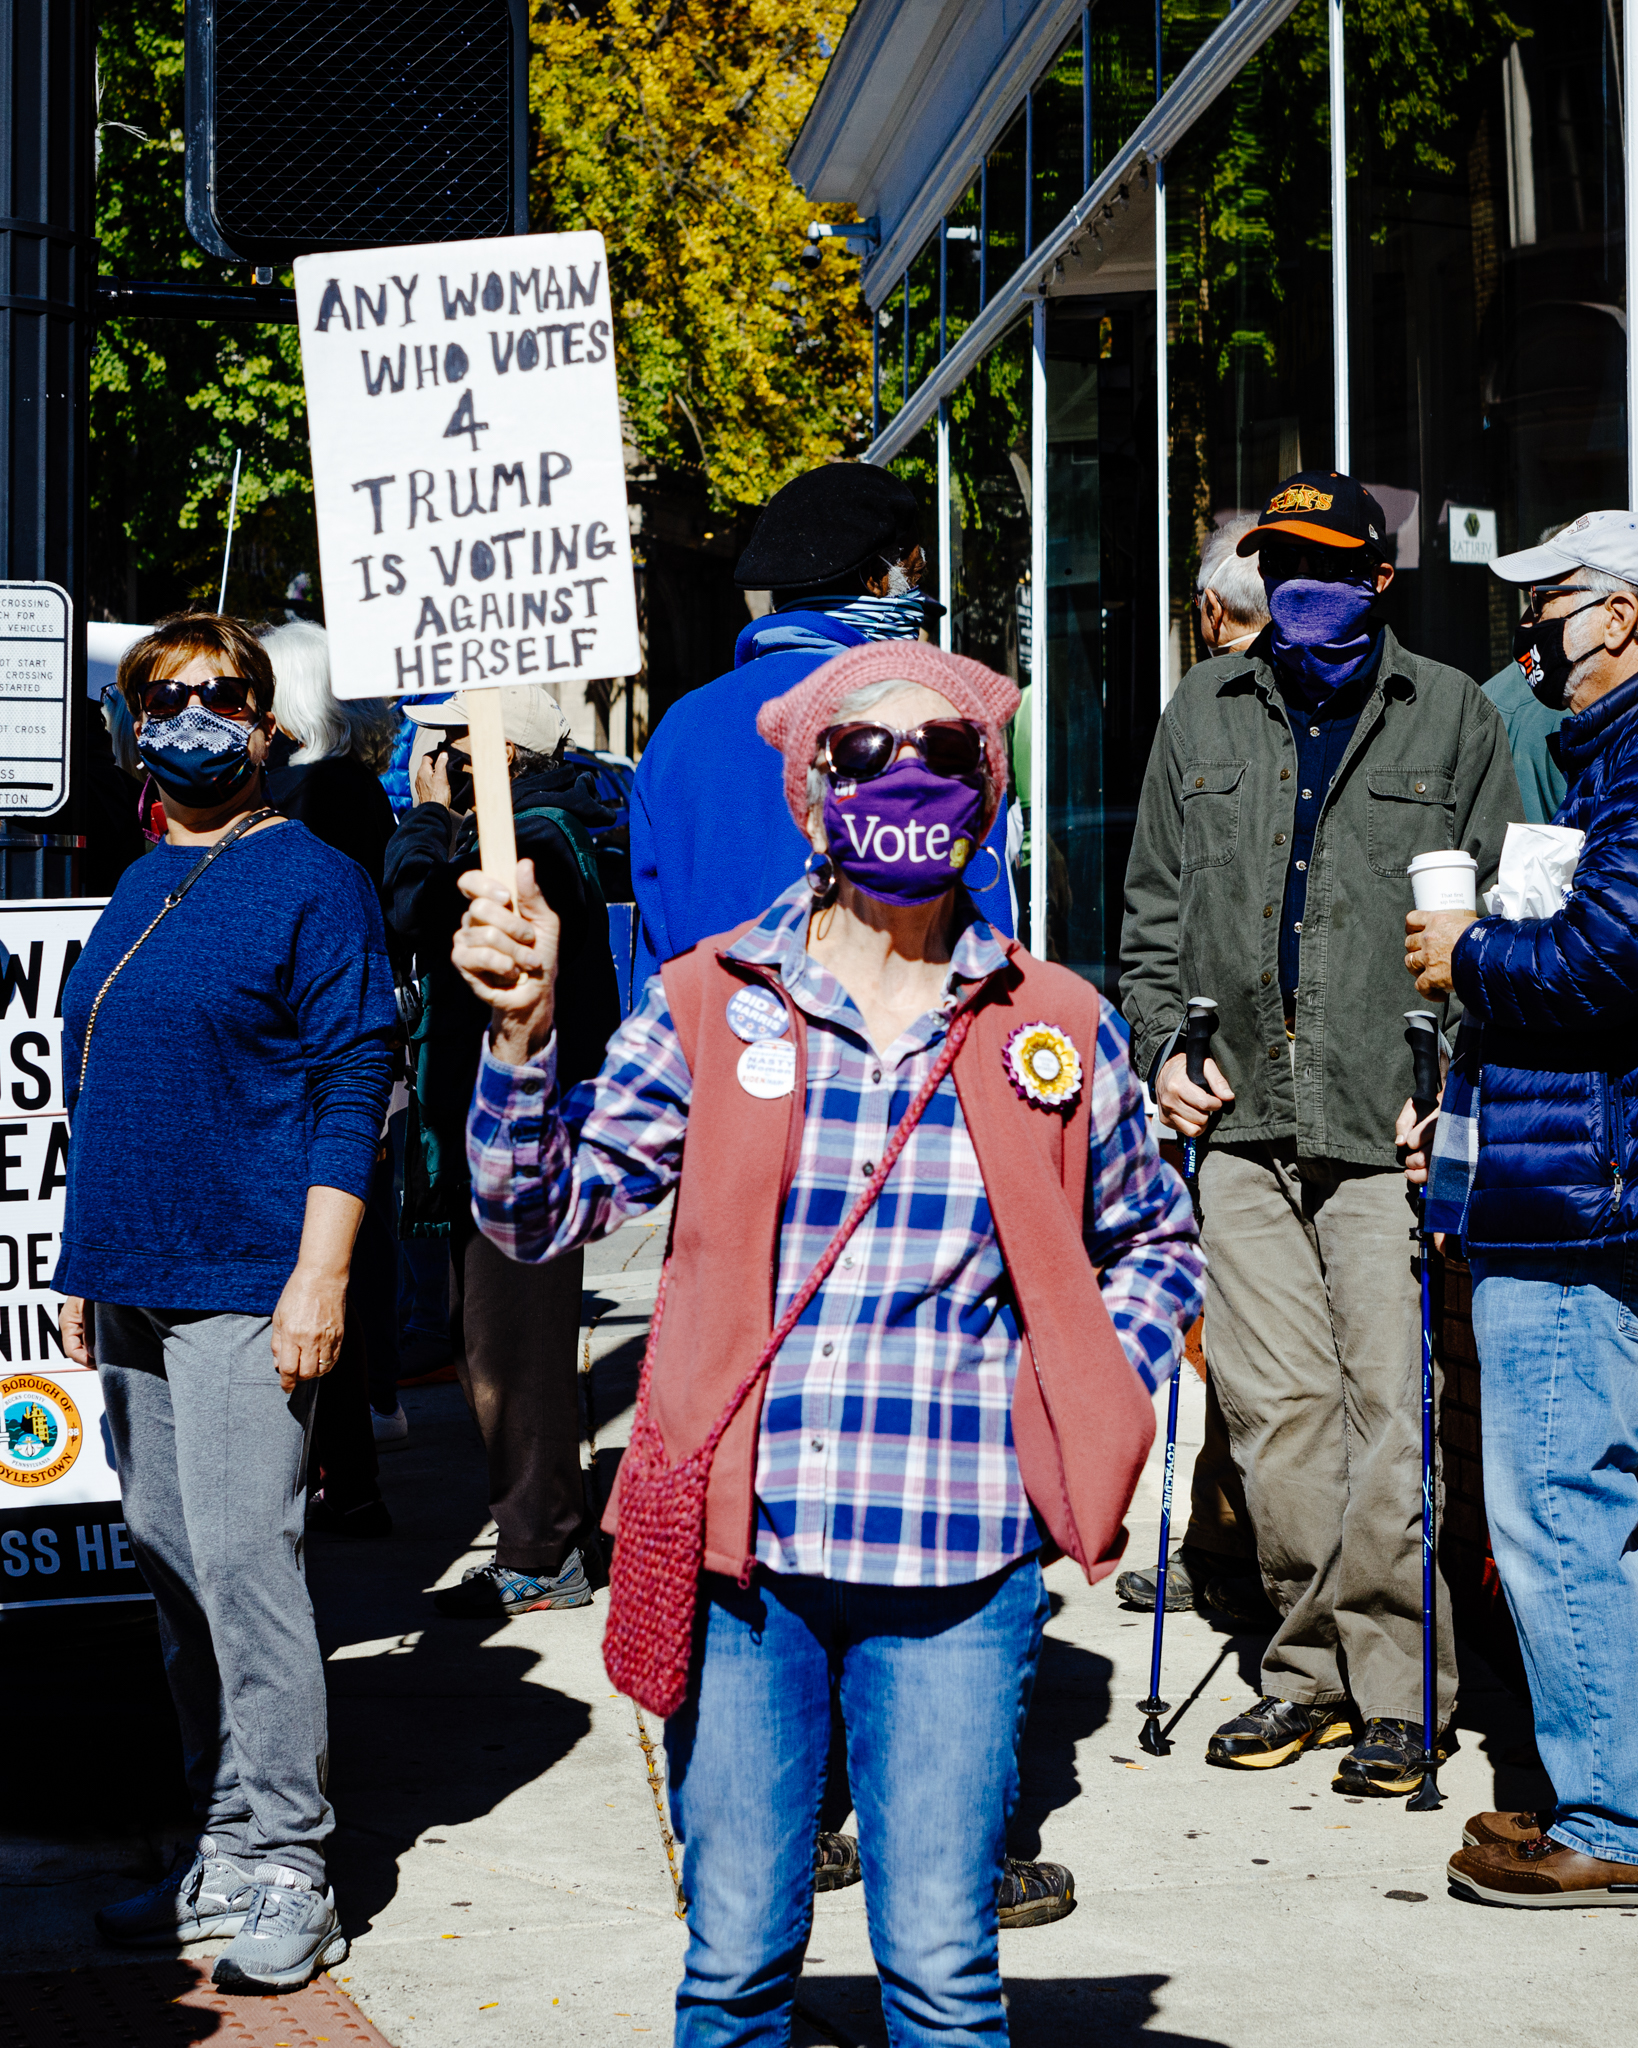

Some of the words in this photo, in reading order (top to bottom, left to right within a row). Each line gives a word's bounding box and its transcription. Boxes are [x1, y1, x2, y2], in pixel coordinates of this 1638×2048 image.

[314, 273, 418, 332] ANY
[439, 261, 601, 320] WOMAN
[361, 342, 470, 396] WHO
[488, 320, 610, 375] VOTES
[442, 388, 490, 452] 4
[351, 451, 573, 535] TRUMP
[1266, 488, 1333, 514] KEYS
[352, 555, 407, 602] IS
[430, 521, 618, 587] VOTING
[2, 599, 50, 608] CROSSING
[414, 576, 609, 640] AGAINST
[8, 624, 54, 632] VEHICLES
[6, 671, 53, 680] CROSSING
[18, 659, 47, 668] START
[395, 628, 598, 689] HERSELF
[14, 725, 47, 734] CROSS
[842, 813, 950, 863] Vote
[730, 1001, 781, 1032] HARRIS
[736, 990, 789, 1023] BIDEN
[2, 1378, 60, 1398] BOROUGH
[60, 1397, 74, 1413] OF
[23, 1394, 46, 1403] COUNTY
[12, 1458, 51, 1468] PENNSYLVANIA
[1, 1528, 61, 1577] SS
